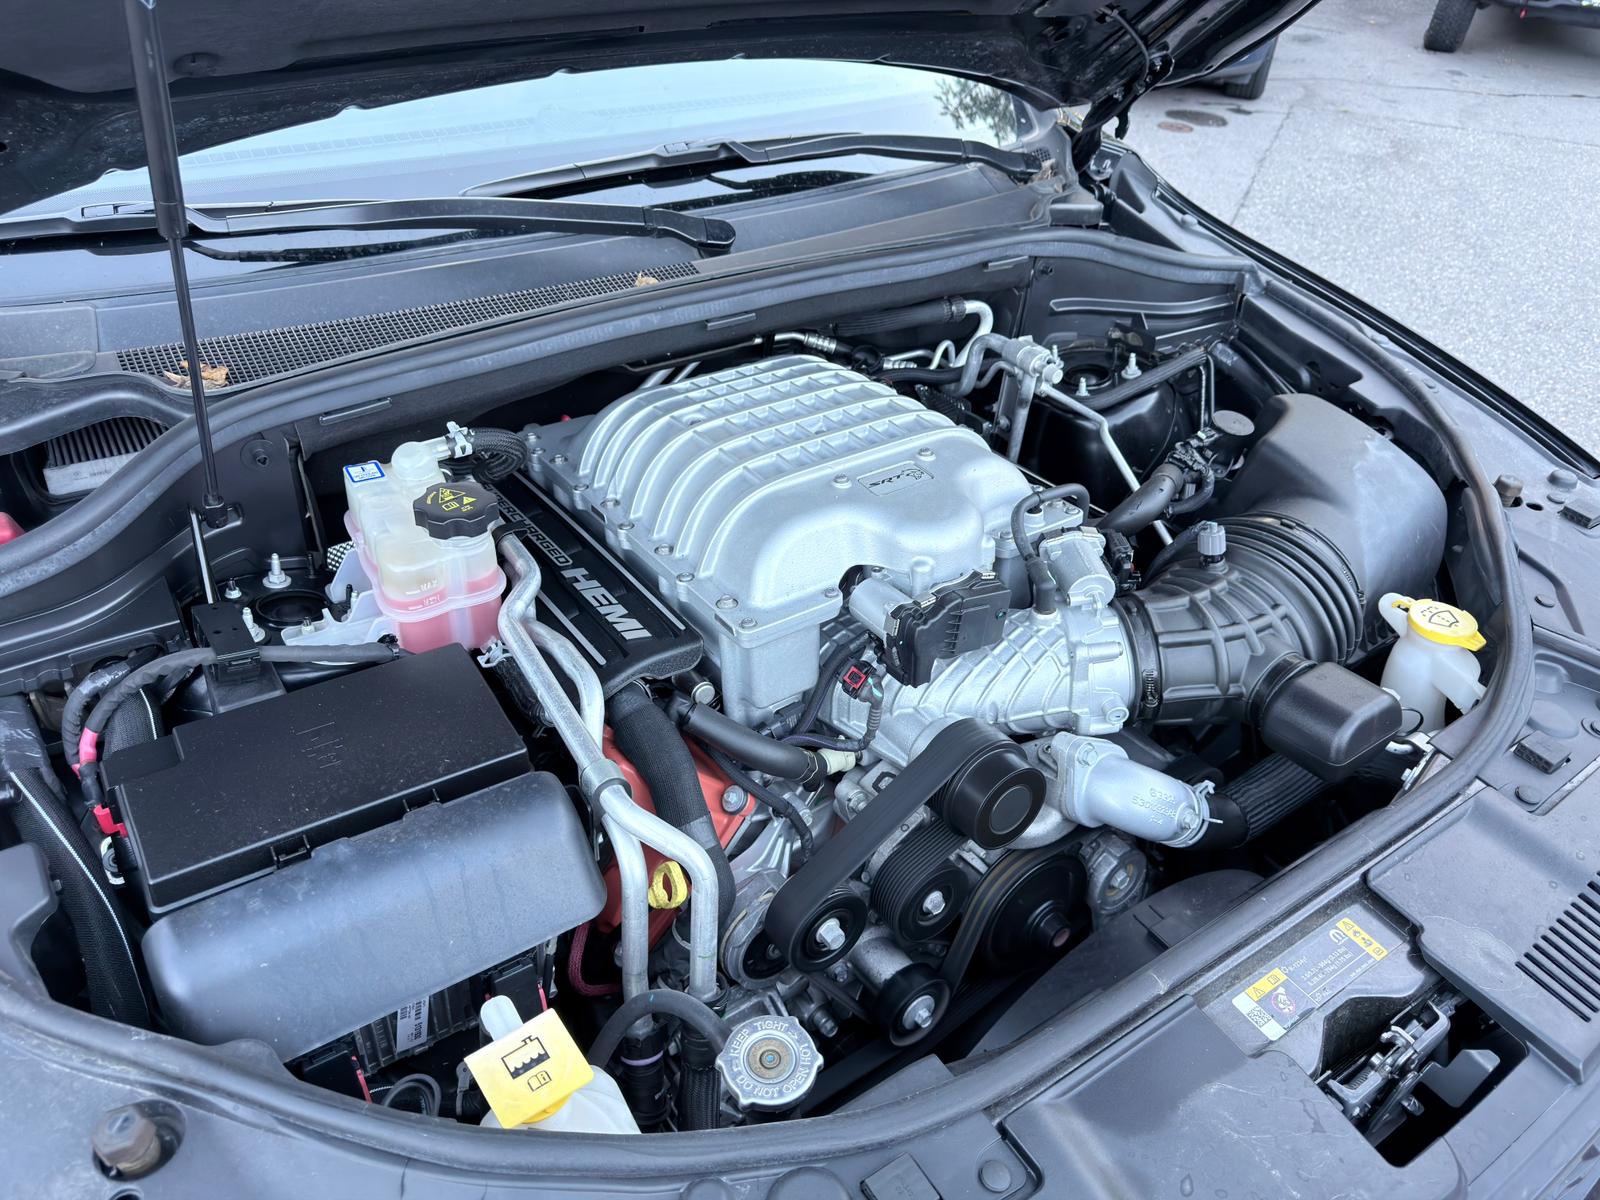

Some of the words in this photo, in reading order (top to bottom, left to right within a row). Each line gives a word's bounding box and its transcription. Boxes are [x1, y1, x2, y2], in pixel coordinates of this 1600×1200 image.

[868, 473, 905, 488] SRT
[561, 567, 652, 640] HEMI
[729, 1028, 750, 1057] KEEP
[753, 1020, 789, 1032] TIGHT
[736, 1075, 753, 1090] DO
[753, 1085, 780, 1098] NOT
[782, 1064, 810, 1094] OPEN
[799, 1043, 812, 1065] HOT
